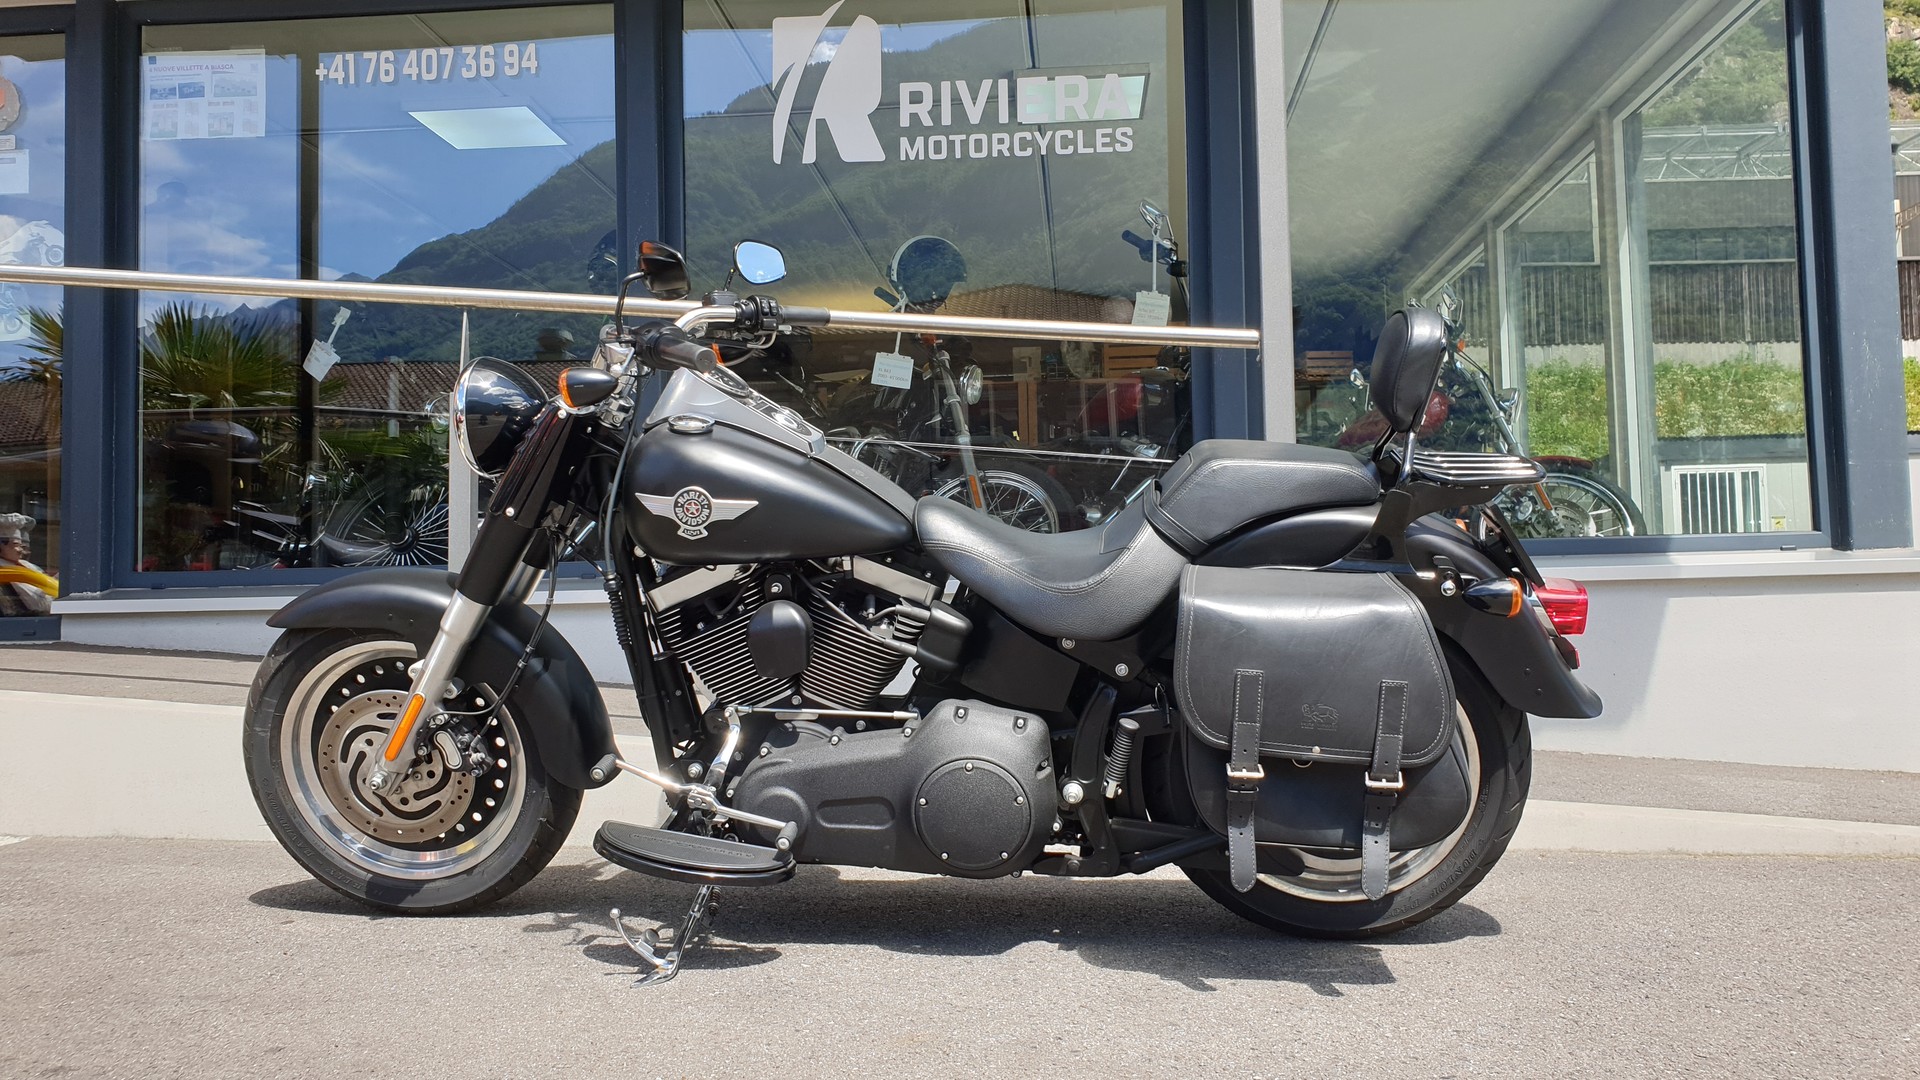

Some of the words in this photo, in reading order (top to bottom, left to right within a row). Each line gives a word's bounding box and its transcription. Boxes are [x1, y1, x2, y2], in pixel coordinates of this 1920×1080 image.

[316, 54, 354, 84] +41
[363, 51, 395, 83] 76
[403, 48, 454, 81] 407
[461, 45, 495, 78] 36
[503, 43, 538, 75] 94
[900, 73, 1132, 127] RIVIERA
[900, 127, 1134, 161] MOTORCYCLES
[678, 491, 708, 505] HARLEY
[675, 507, 710, 526] DAVIDSON
